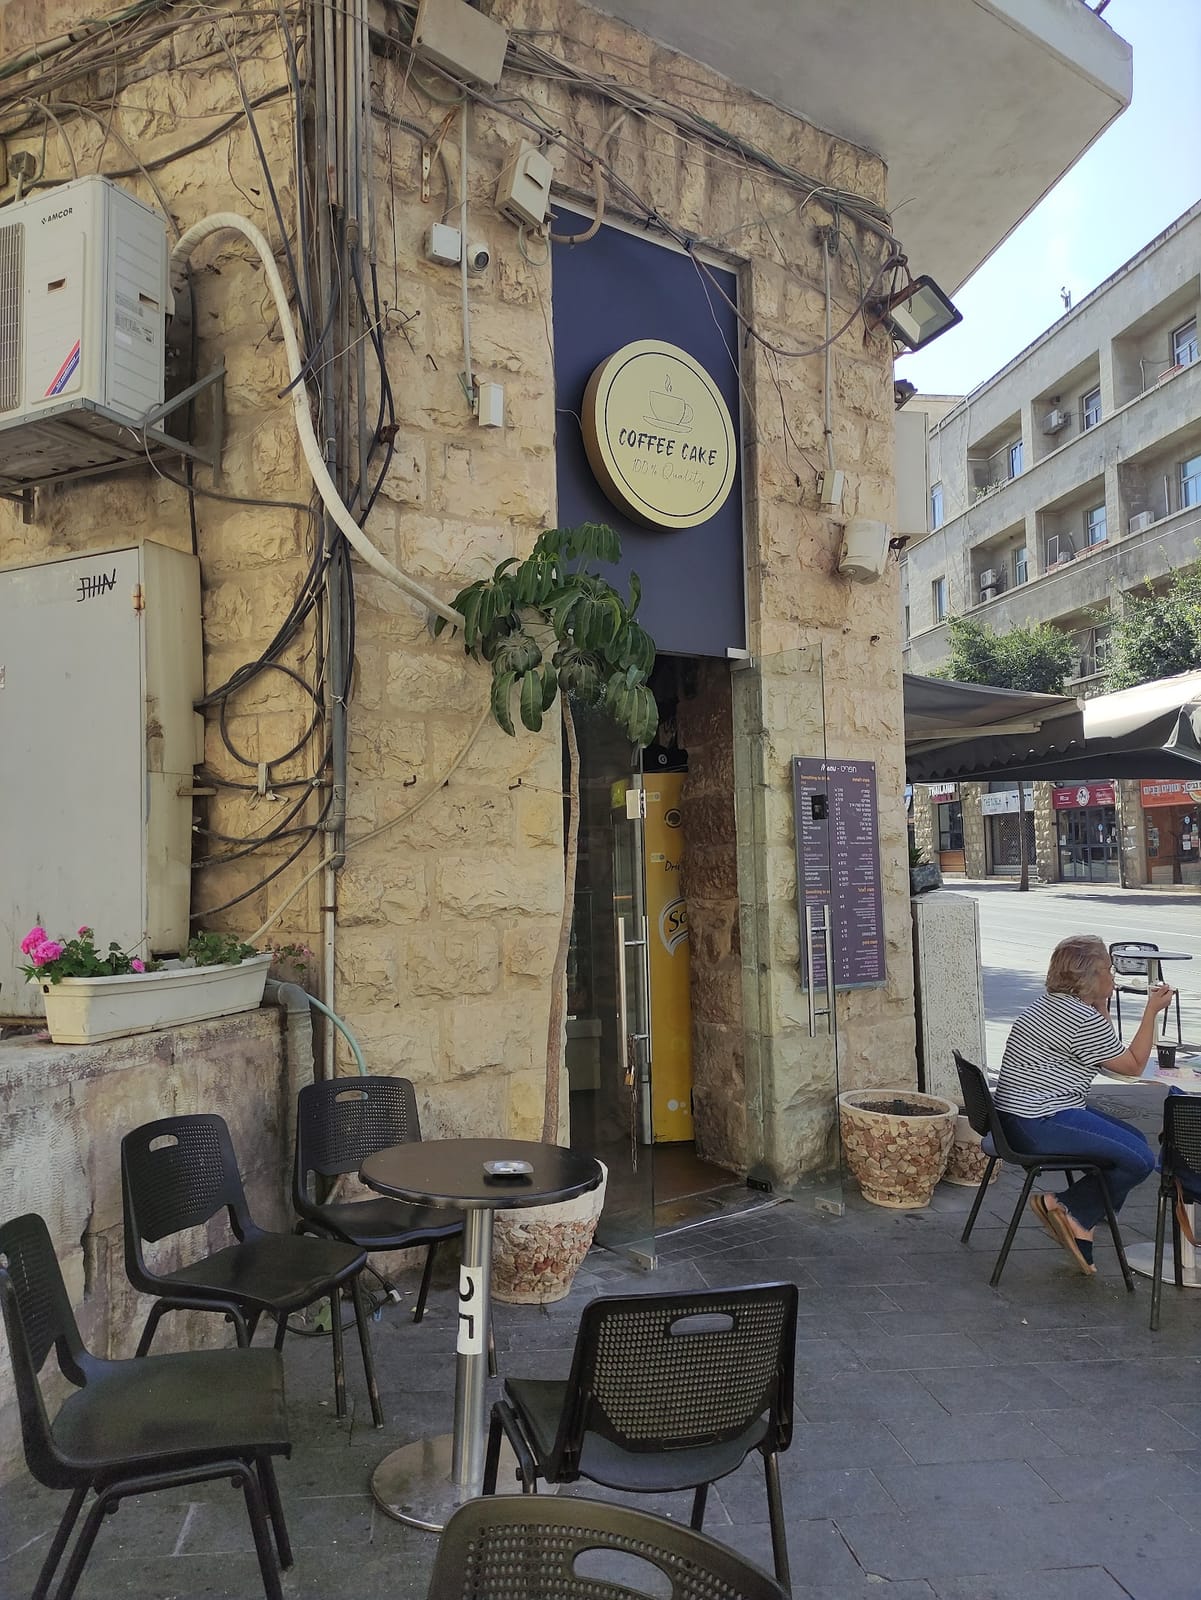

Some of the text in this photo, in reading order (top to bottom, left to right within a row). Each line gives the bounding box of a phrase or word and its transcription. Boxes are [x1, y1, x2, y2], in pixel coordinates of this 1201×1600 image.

[48, 207, 73, 222] AMCOR
[618, 428, 718, 466] COFFEE CAKE
[632, 458, 705, 493] 100% Quality
